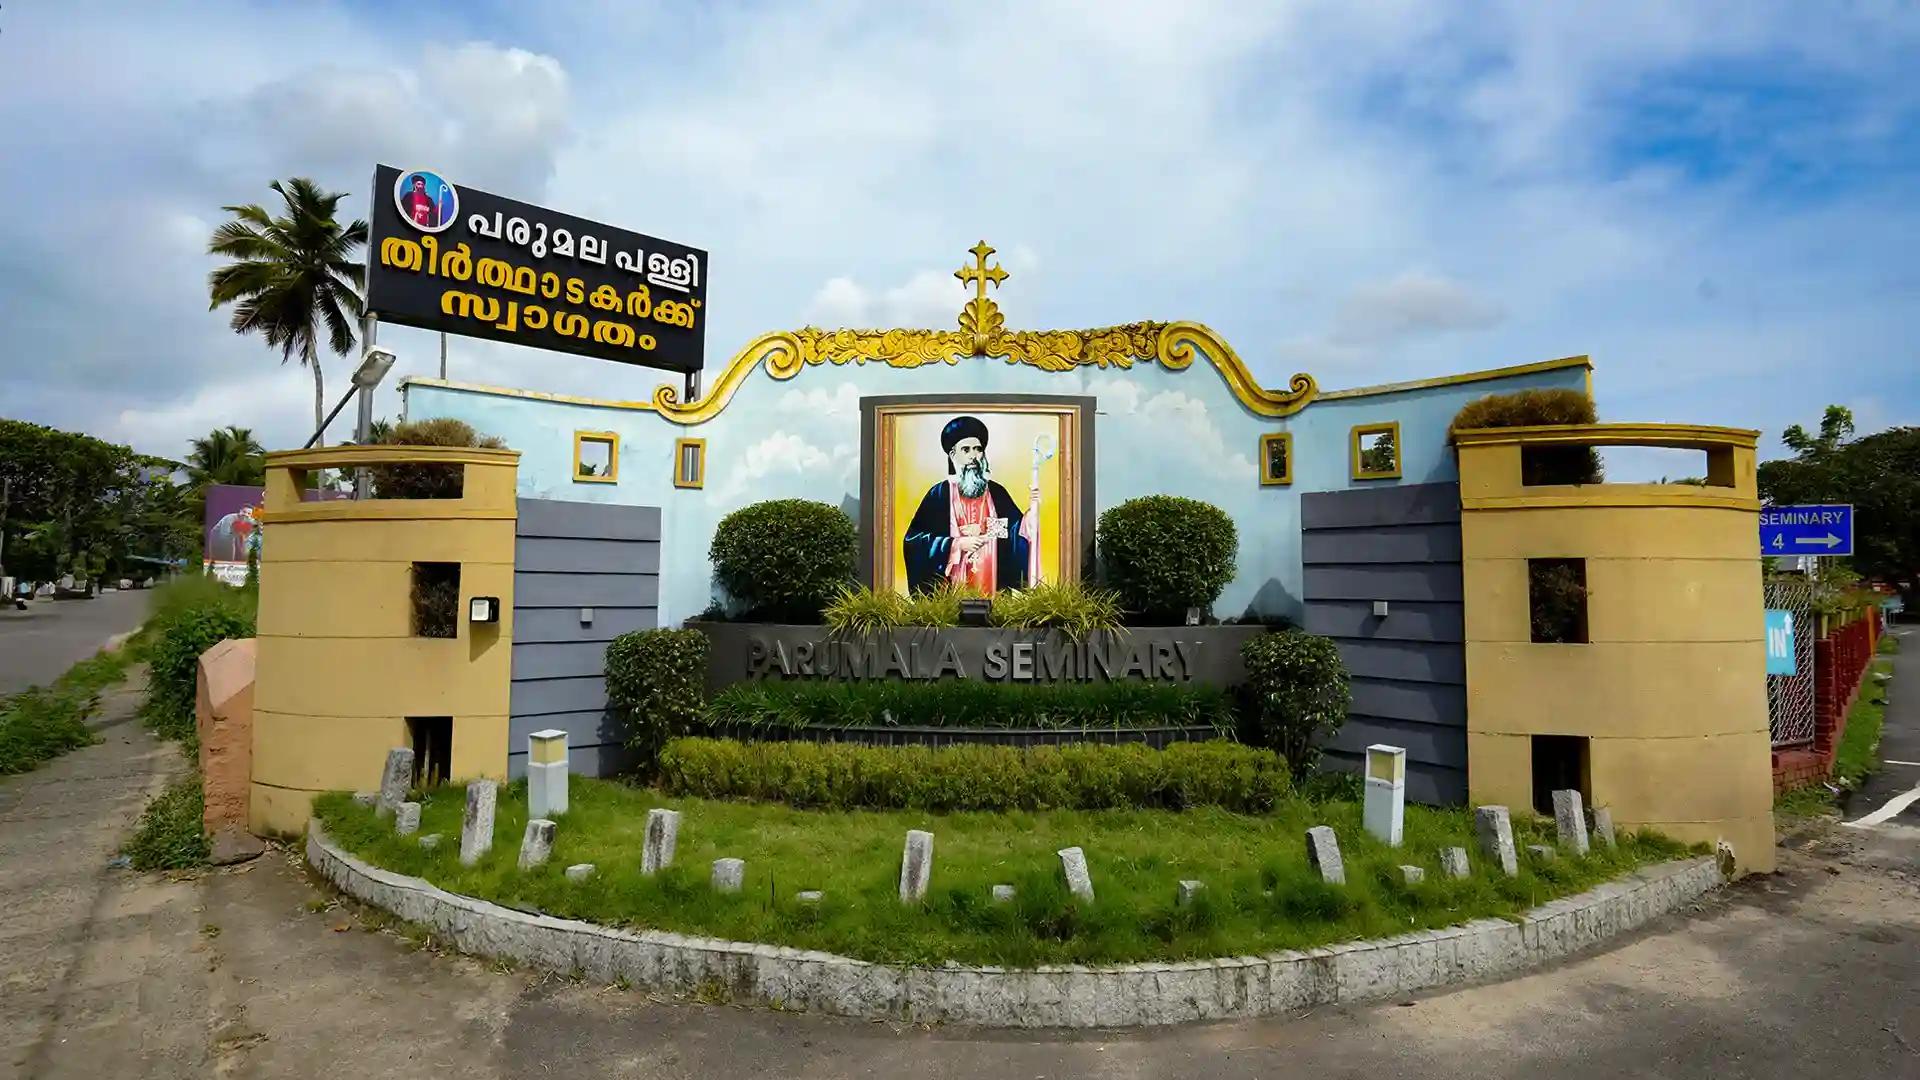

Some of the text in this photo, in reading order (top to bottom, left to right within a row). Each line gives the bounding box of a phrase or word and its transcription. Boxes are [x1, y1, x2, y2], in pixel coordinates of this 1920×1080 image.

[468, 212, 699, 293] പരുമല പള്ളി
[380, 235, 702, 329] തീർത്ഥാടകർക്ക്
[440, 290, 657, 351] സ്വാഗതം
[1760, 512, 1844, 525] SEMINARY
[1772, 532, 1784, 550] 4
[747, 639, 1203, 680] PARUMALA SEMINARY
